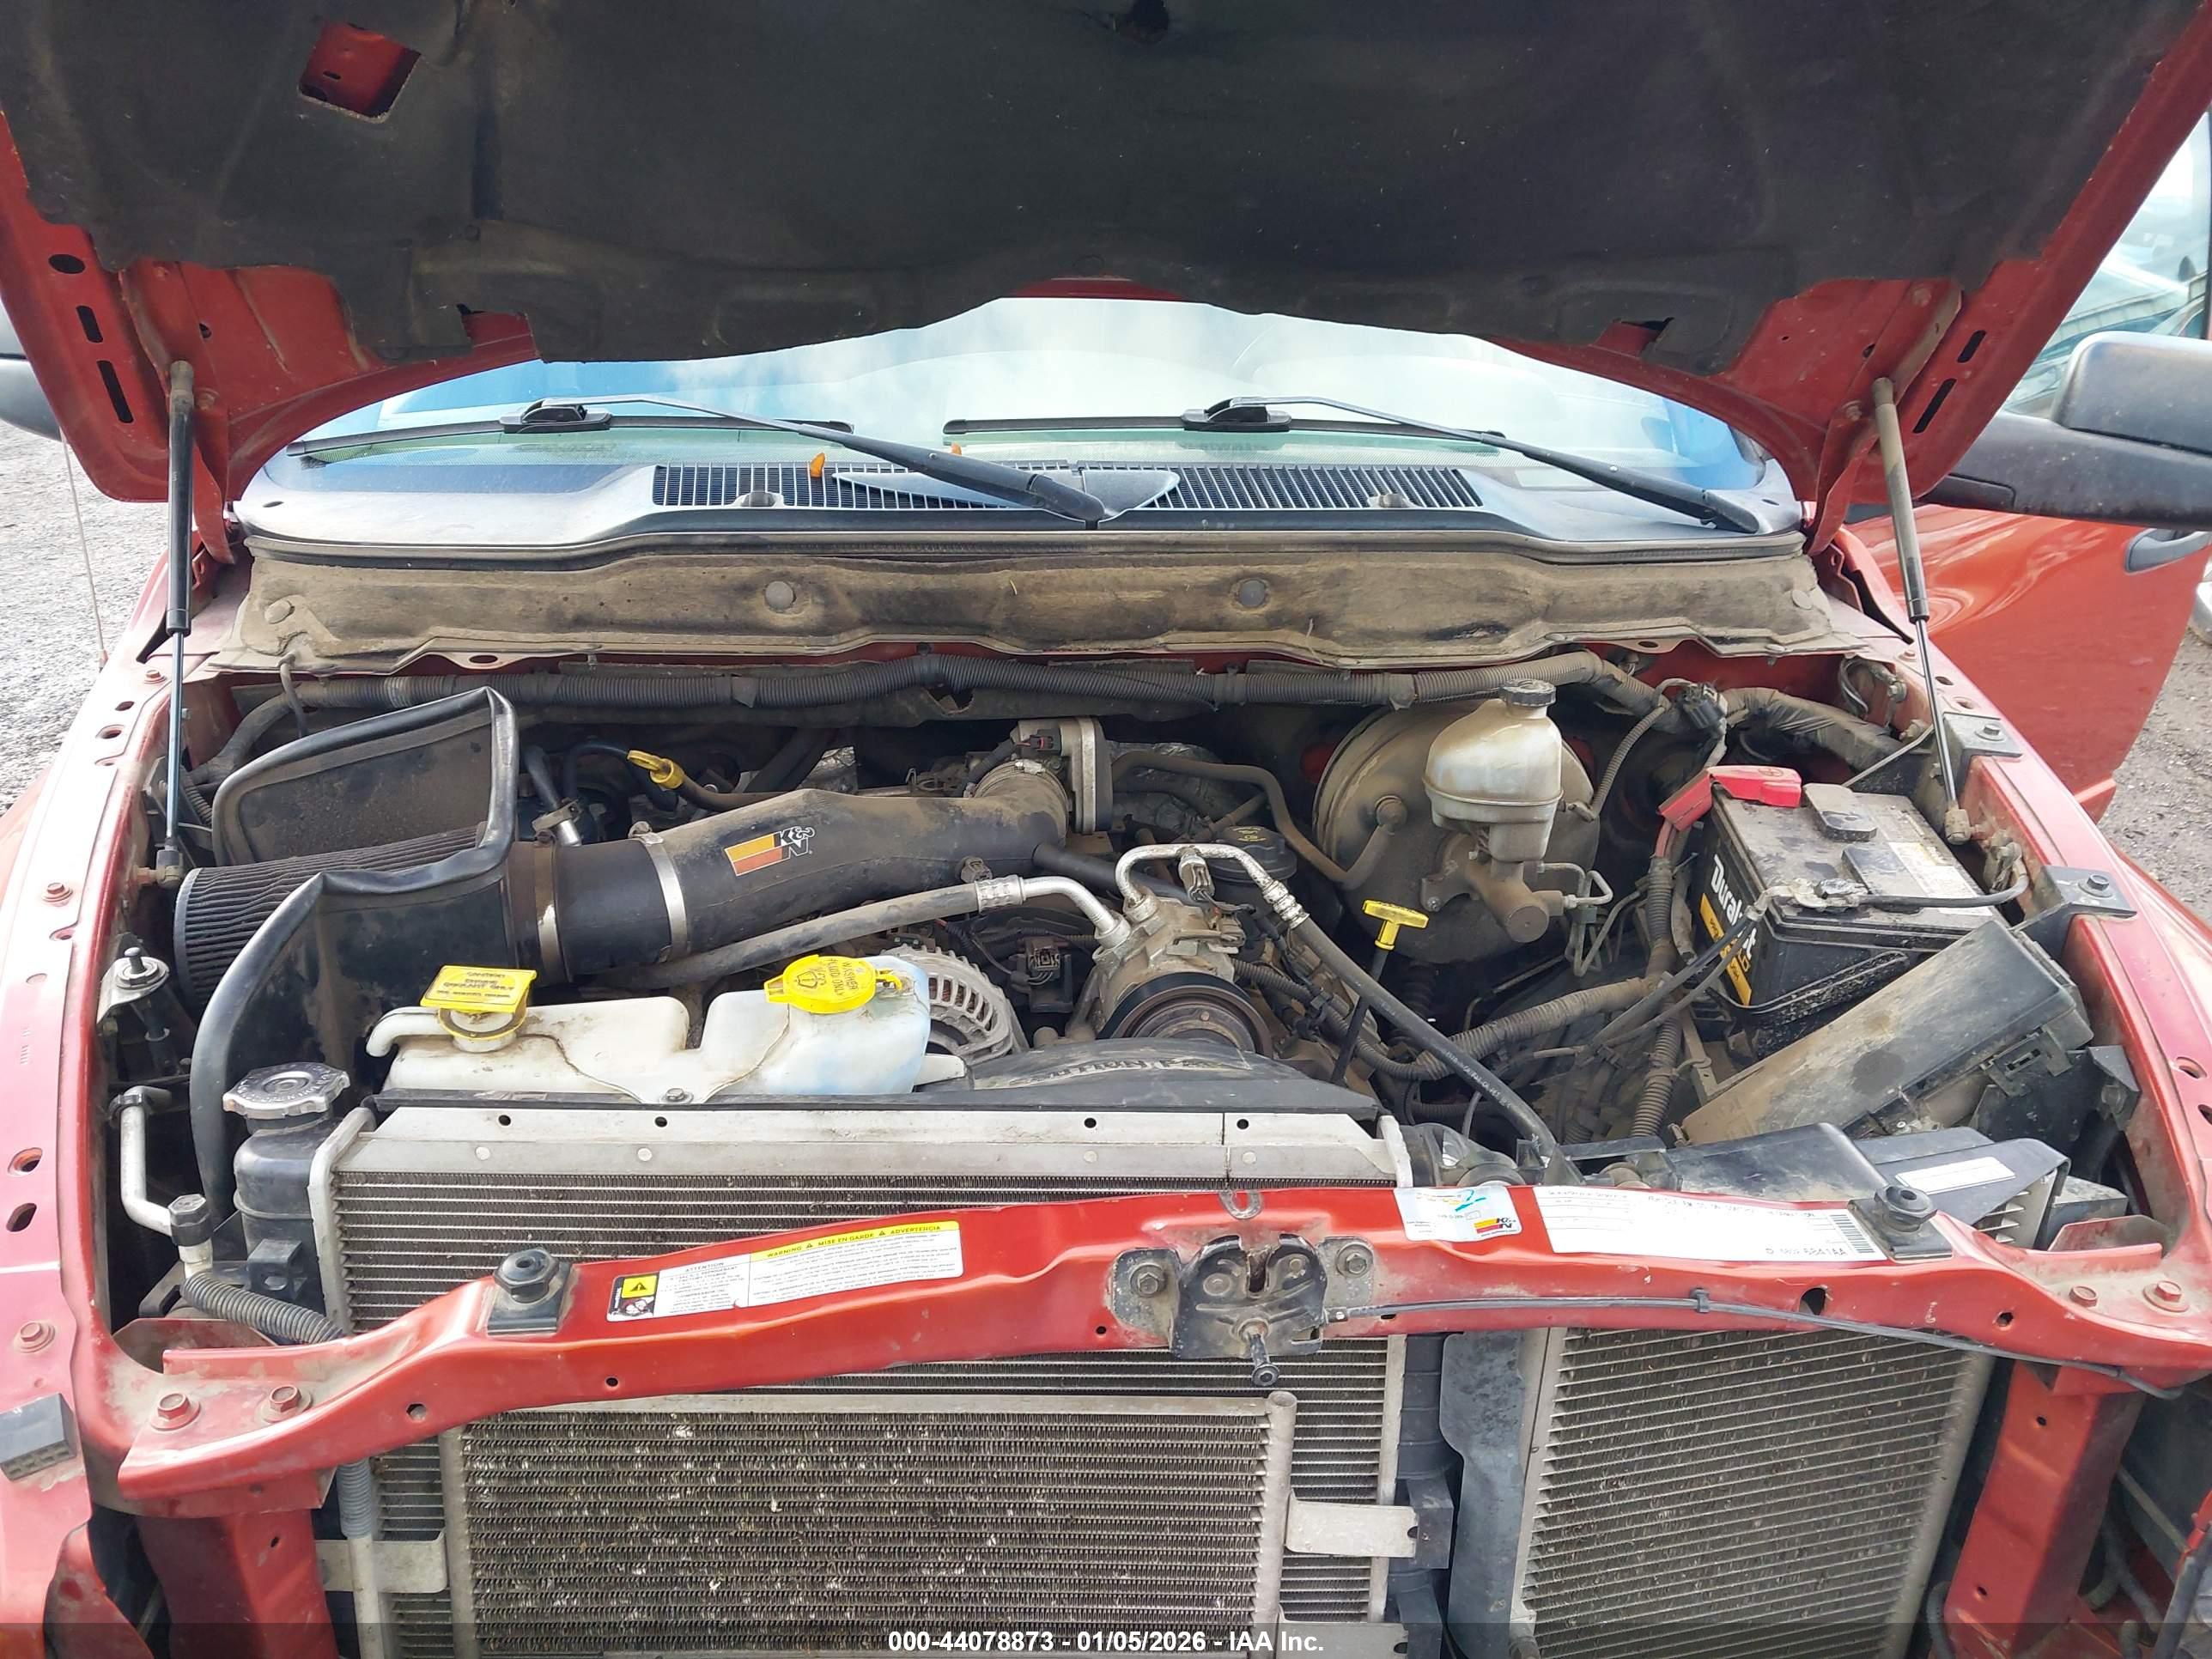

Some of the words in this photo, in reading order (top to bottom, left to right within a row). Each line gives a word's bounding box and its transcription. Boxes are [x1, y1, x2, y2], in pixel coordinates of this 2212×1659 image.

[1711, 853, 1757, 961] Duralt
[827, 957, 841, 976] FLUID
[842, 961, 859, 991] WASHER
[832, 976, 846, 996] ONLY
[767, 1246, 803, 1257] WARNING
[849, 1232, 874, 1242] GARDE
[890, 1225, 942, 1235] ADVERTENCIA
